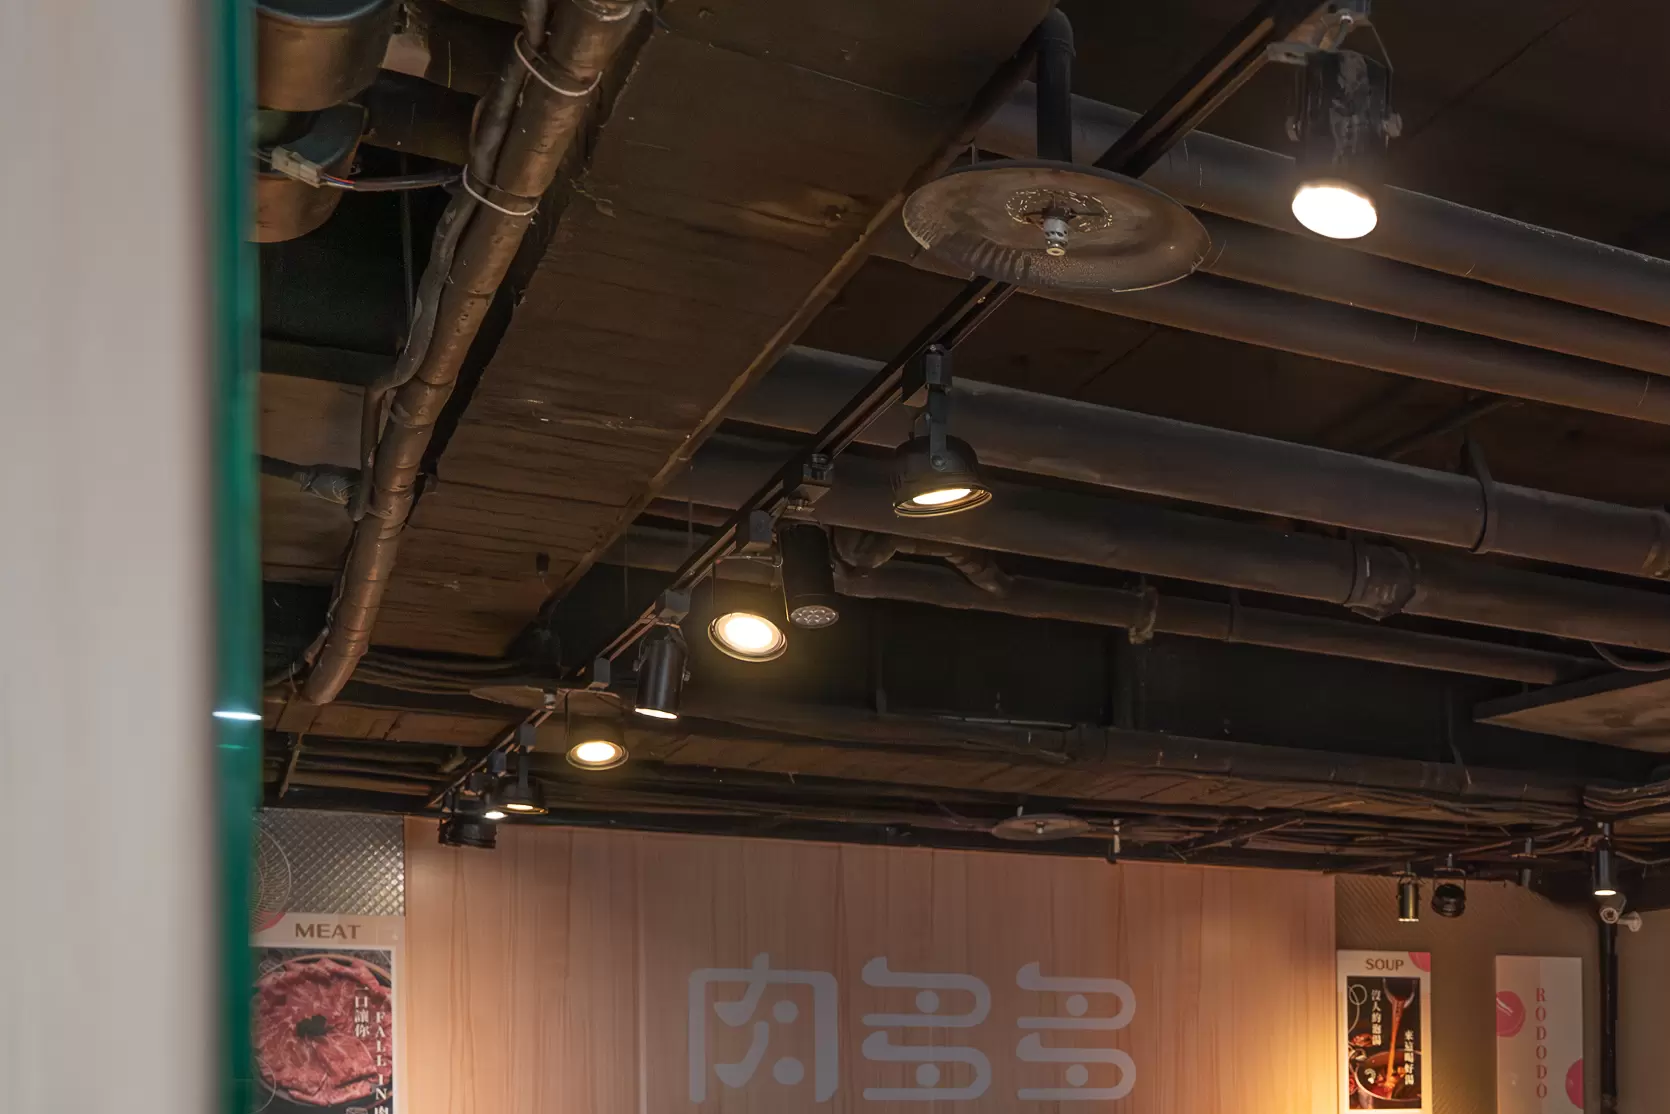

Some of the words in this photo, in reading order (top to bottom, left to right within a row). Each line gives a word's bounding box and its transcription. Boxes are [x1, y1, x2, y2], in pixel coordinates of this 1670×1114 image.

[295, 923, 361, 939] MEAT
[1365, 958, 1404, 972] SOUP
[376, 1011, 386, 1067] FALL
[689, 952, 1137, 1103] 肉多多
[1536, 987, 1547, 1099] RODODO
[376, 1073, 387, 1100] IN
